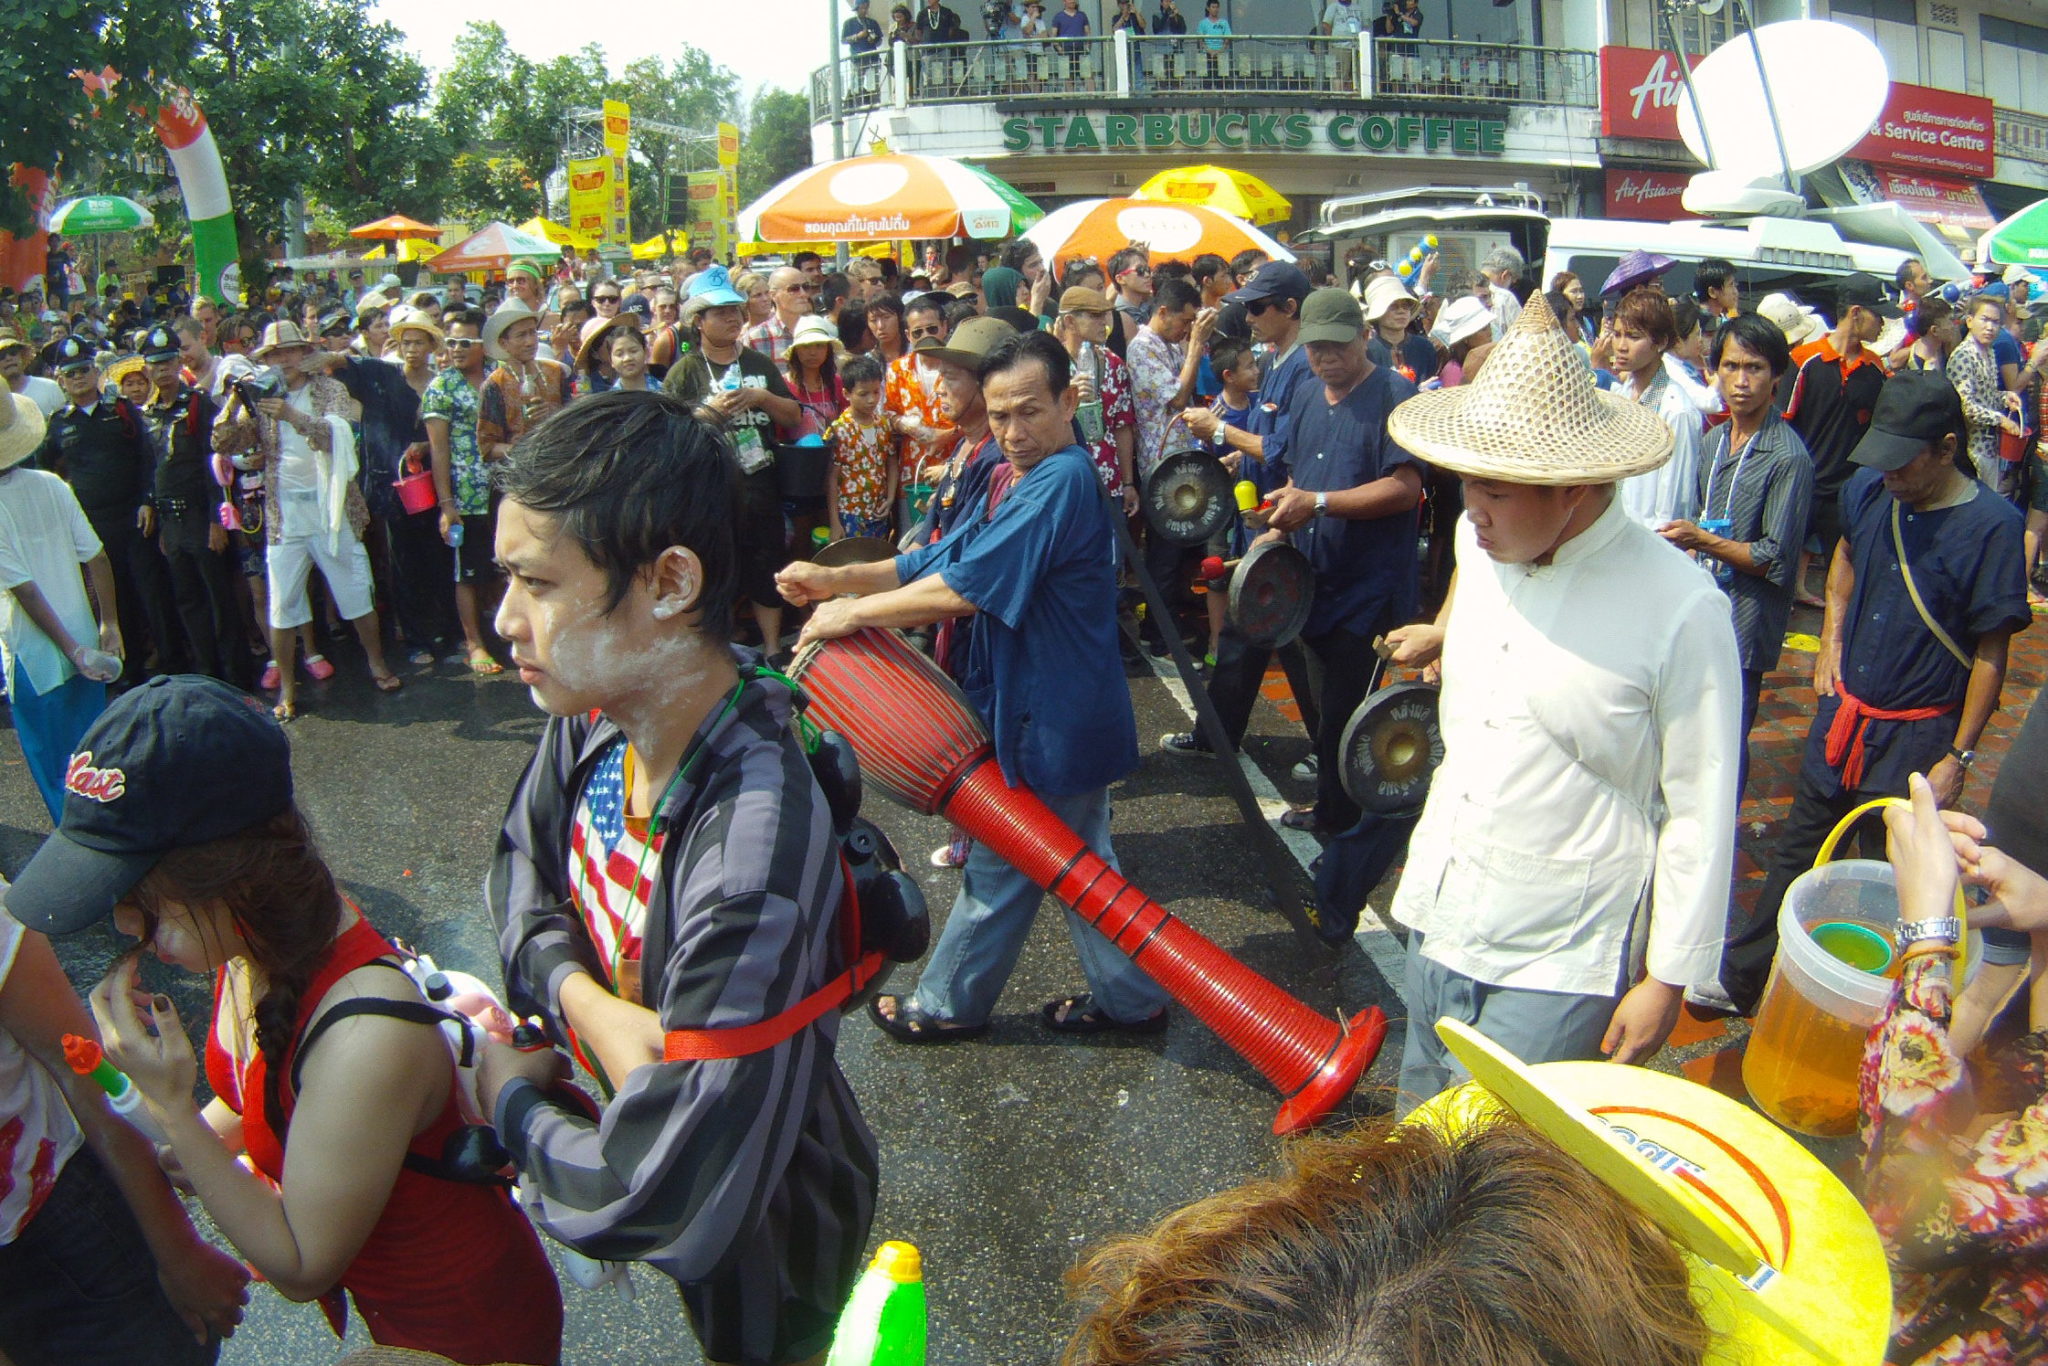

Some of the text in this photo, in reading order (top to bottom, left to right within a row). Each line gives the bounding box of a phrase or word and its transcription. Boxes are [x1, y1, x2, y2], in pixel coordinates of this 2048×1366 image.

[1002, 112, 1506, 153] STARBUCKS COFFEE
[1885, 122, 1938, 144] Service
[1940, 130, 1985, 151] Centre
